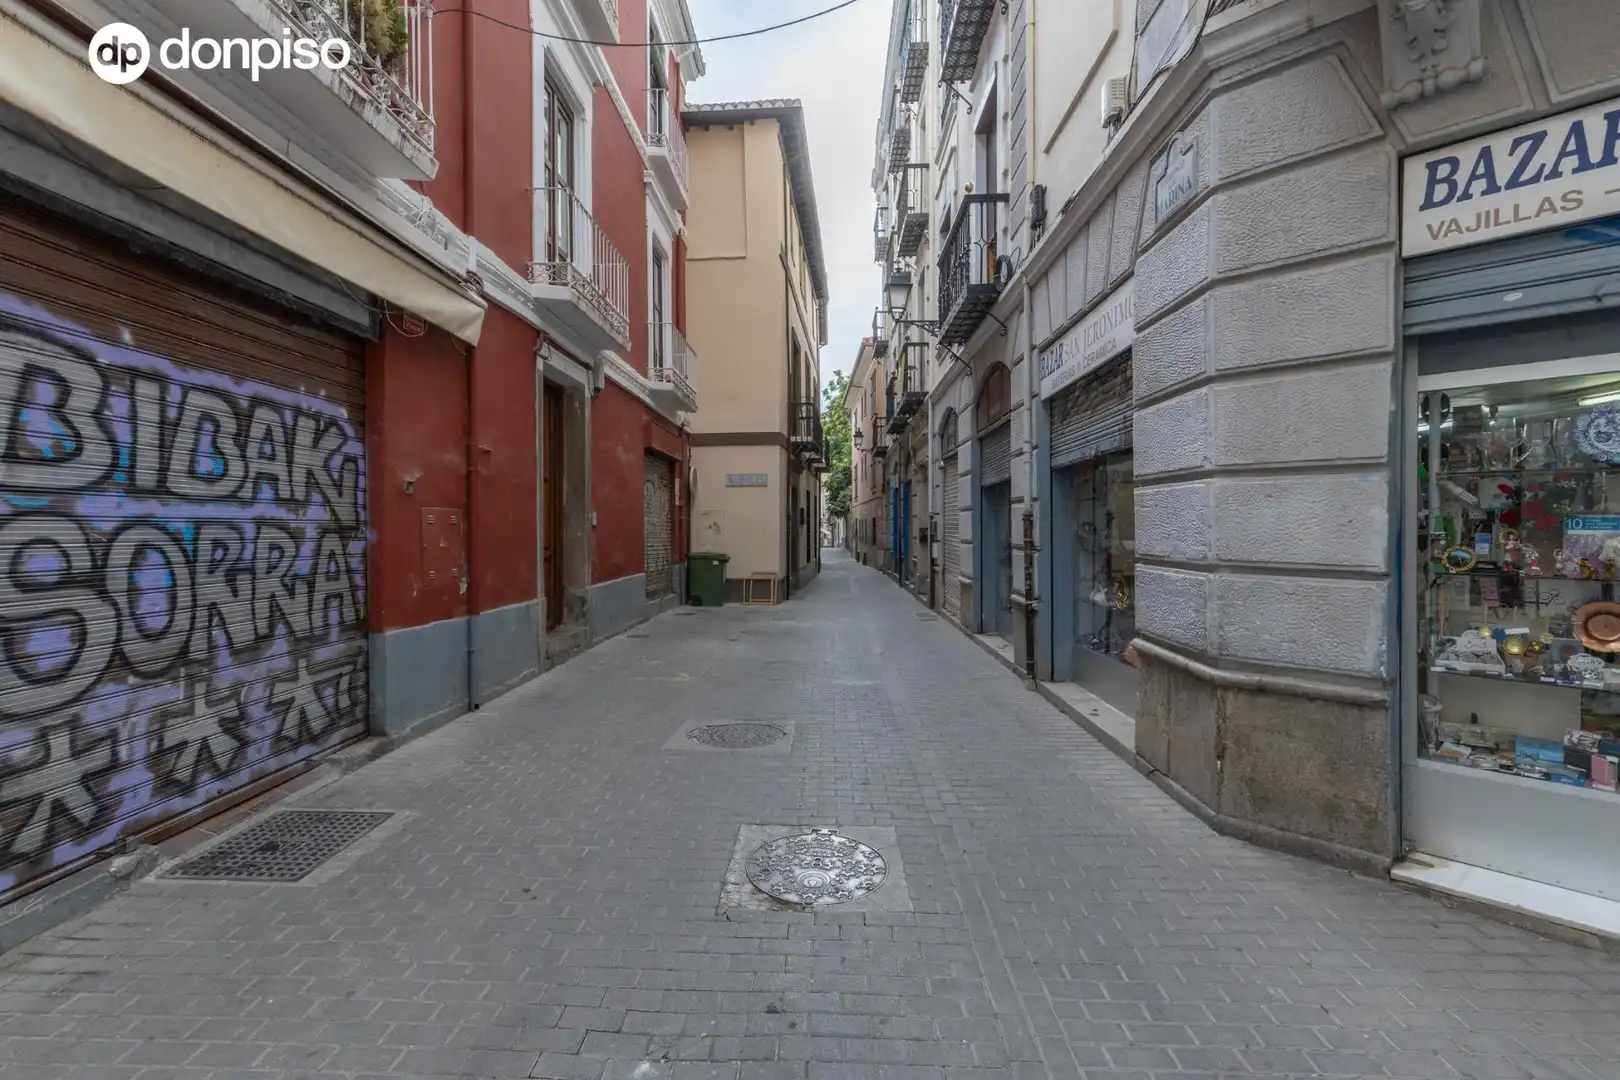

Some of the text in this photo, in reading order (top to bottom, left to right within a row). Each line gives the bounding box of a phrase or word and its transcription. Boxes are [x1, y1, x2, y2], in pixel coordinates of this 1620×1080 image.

[1426, 190, 1584, 240] VAJILLAS
[1040, 343, 1064, 380] BAZAR
[1065, 336, 1081, 363] SAN
